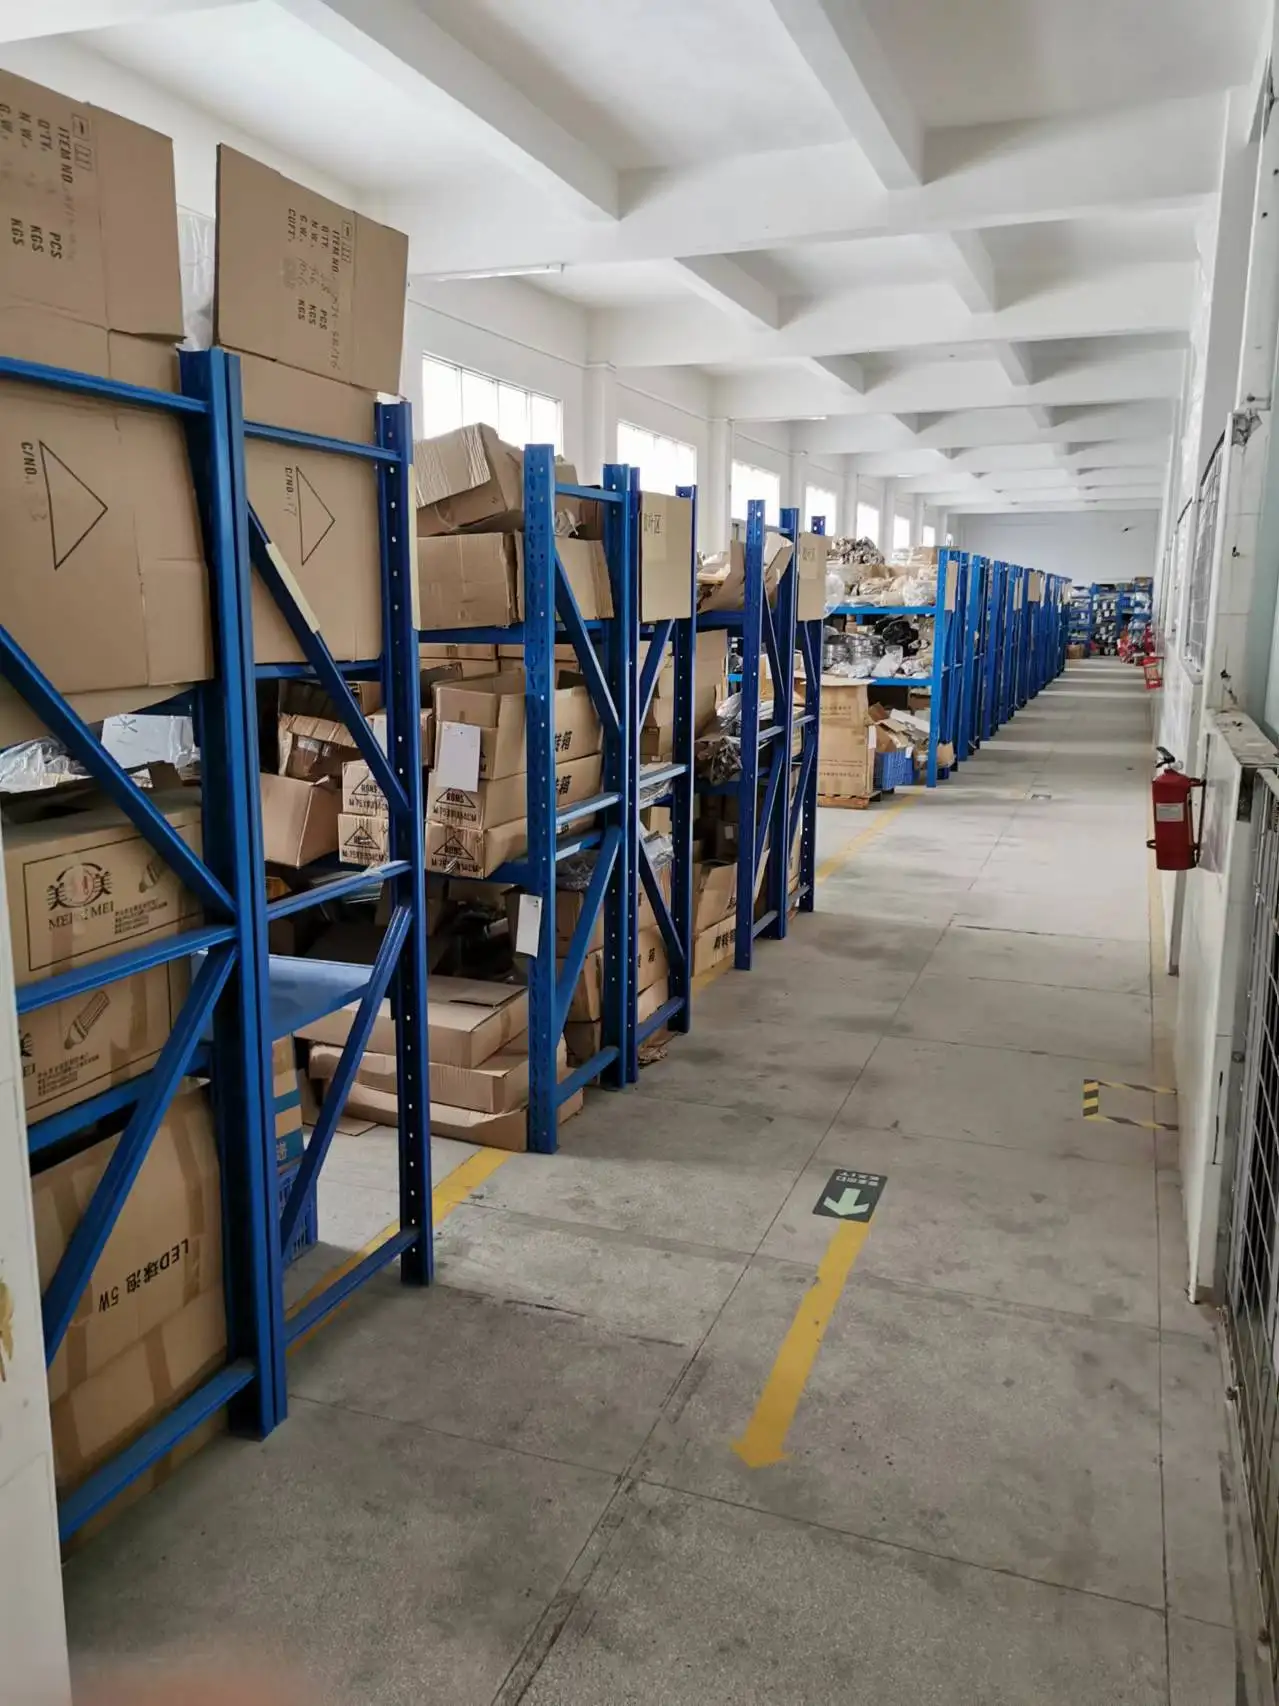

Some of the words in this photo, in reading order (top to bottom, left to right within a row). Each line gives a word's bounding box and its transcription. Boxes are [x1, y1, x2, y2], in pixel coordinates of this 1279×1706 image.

[10, 217, 25, 246] KGS
[29, 224, 44, 253] KGS
[49, 231, 62, 260] PCS
[90, 900, 114, 918] MEI
[98, 1286, 119, 1313] 5W
